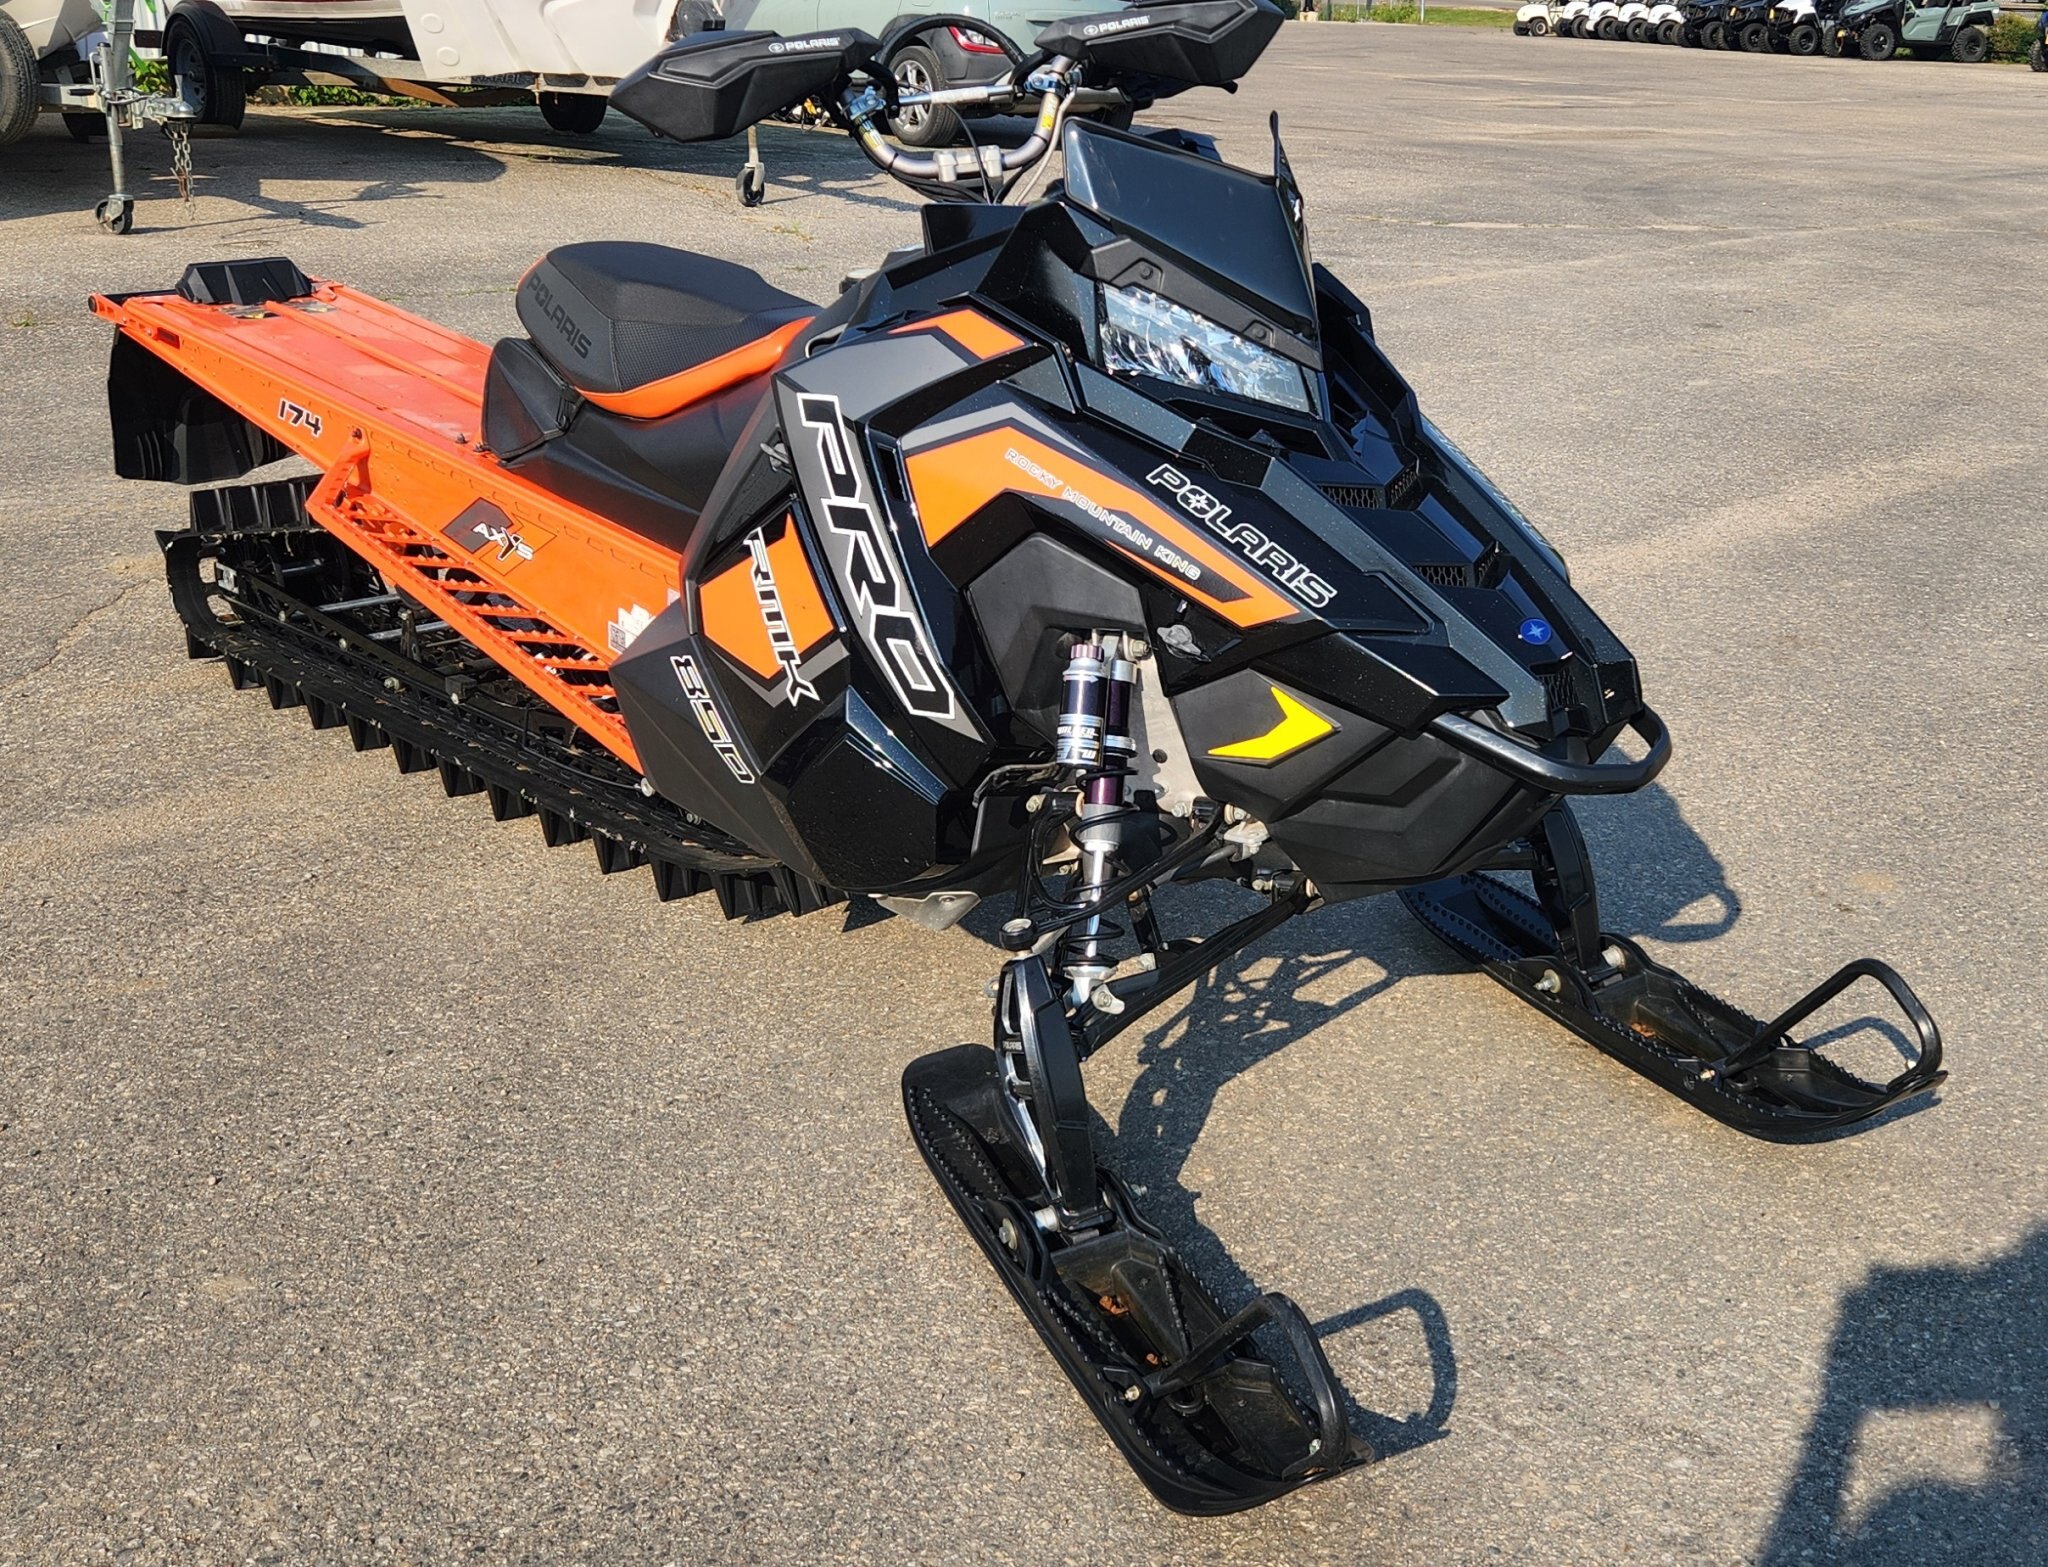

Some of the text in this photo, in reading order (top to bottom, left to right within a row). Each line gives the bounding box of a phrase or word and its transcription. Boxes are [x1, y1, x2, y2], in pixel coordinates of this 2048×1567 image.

[784, 36, 841, 52] POLARIS
[1098, 15, 1150, 33] POLARIS
[526, 272, 592, 360] POLARIS
[277, 397, 323, 438] 174
[797, 392, 955, 720] PRO
[1004, 447, 1202, 581] ROCKY MOUNTAIN KING
[1145, 463, 1338, 608] POLARIS
[743, 527, 820, 707] RMK
[670, 655, 755, 785] 850
